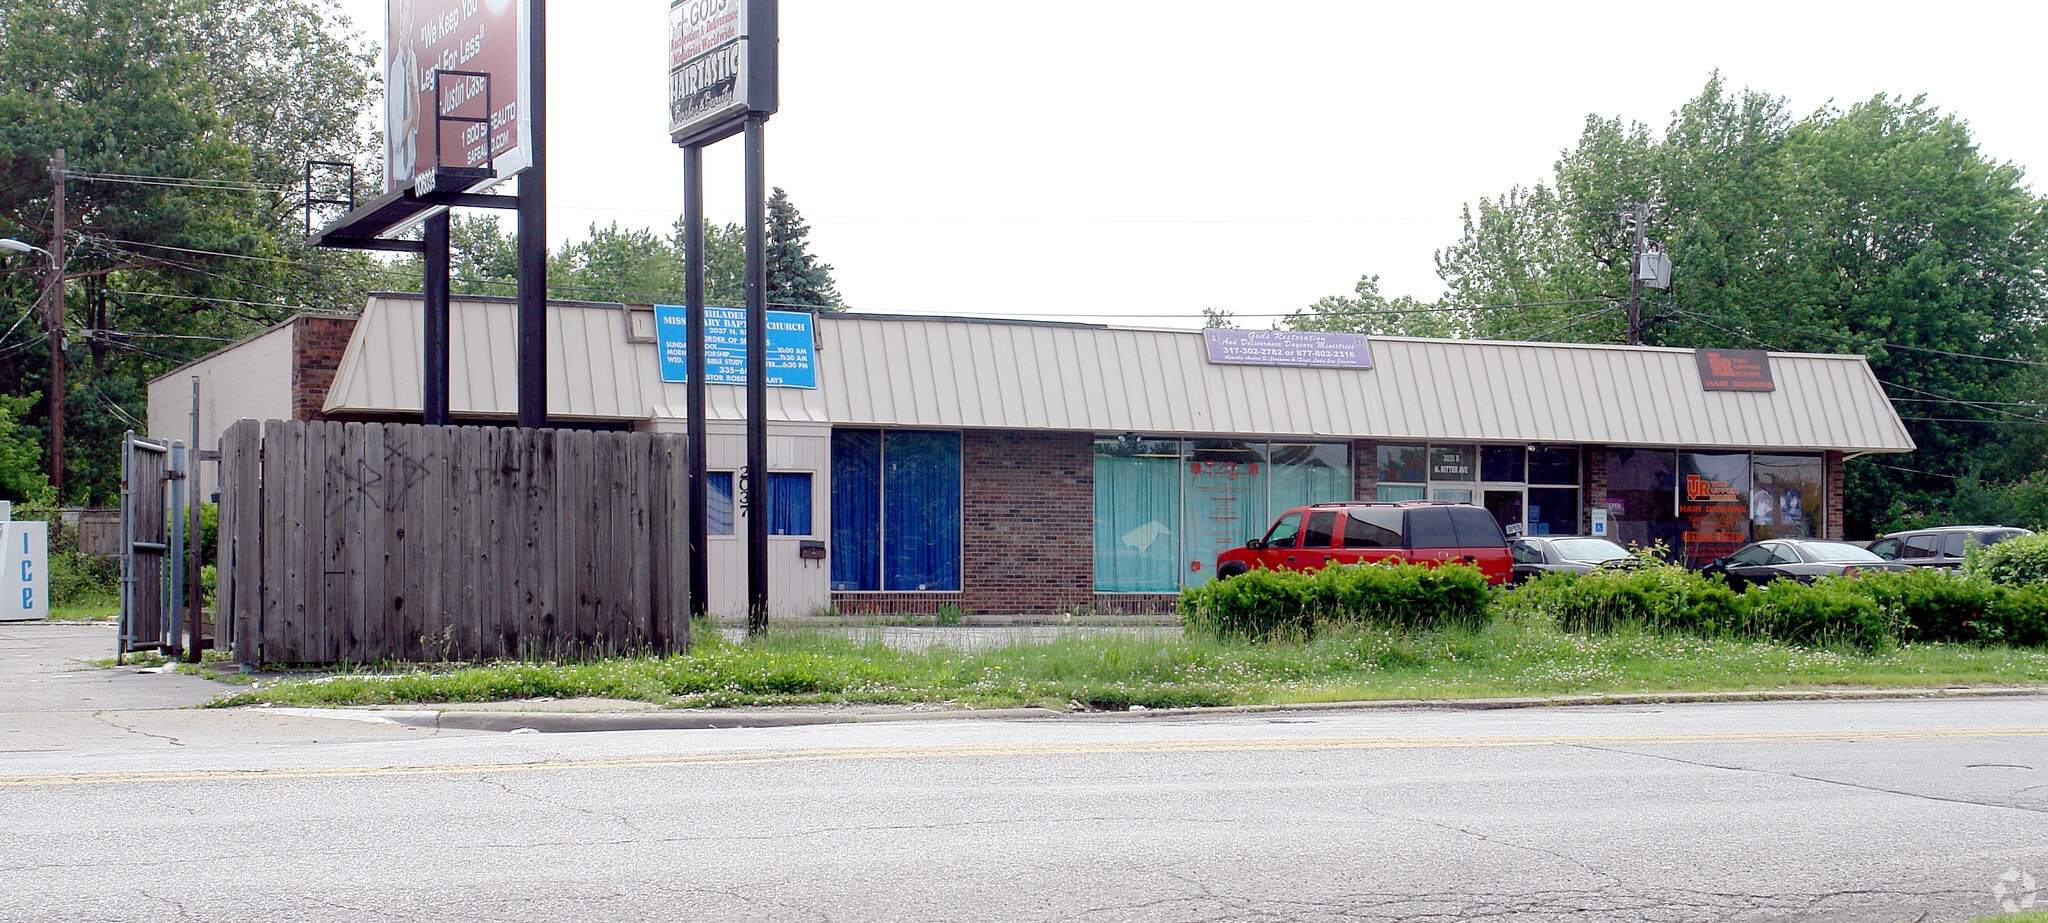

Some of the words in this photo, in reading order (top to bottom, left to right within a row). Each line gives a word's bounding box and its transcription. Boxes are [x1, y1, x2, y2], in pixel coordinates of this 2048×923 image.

[438, 7, 459, 39] Keep
[462, 0, 478, 22] You
[706, 9, 739, 33] Deliverance
[673, 44, 701, 65] Ministries
[701, 26, 735, 50] Worldwide
[443, 48, 458, 74] For
[466, 70, 485, 101] Case
[670, 43, 739, 104] HAIRTASTIC
[467, 130, 510, 166] SAFEAUO.COM
[767, 322, 805, 331] CHURCH
[1247, 332, 1270, 341] Gods
[1273, 333, 1326, 342] Restoration
[1221, 338, 1237, 346] And
[1240, 338, 1282, 348] Deliverance
[1285, 340, 1314, 351] Daycare
[1316, 341, 1355, 350] Ministries
[1223, 346, 1283, 357] 317-302-2782
[1731, 380, 1774, 389] DESIGNS
[1458, 466, 1469, 474] AVE
[739, 465, 748, 518] 2037
[1680, 505, 1701, 513] HAIR
[1705, 505, 1747, 513] DESIGNS
